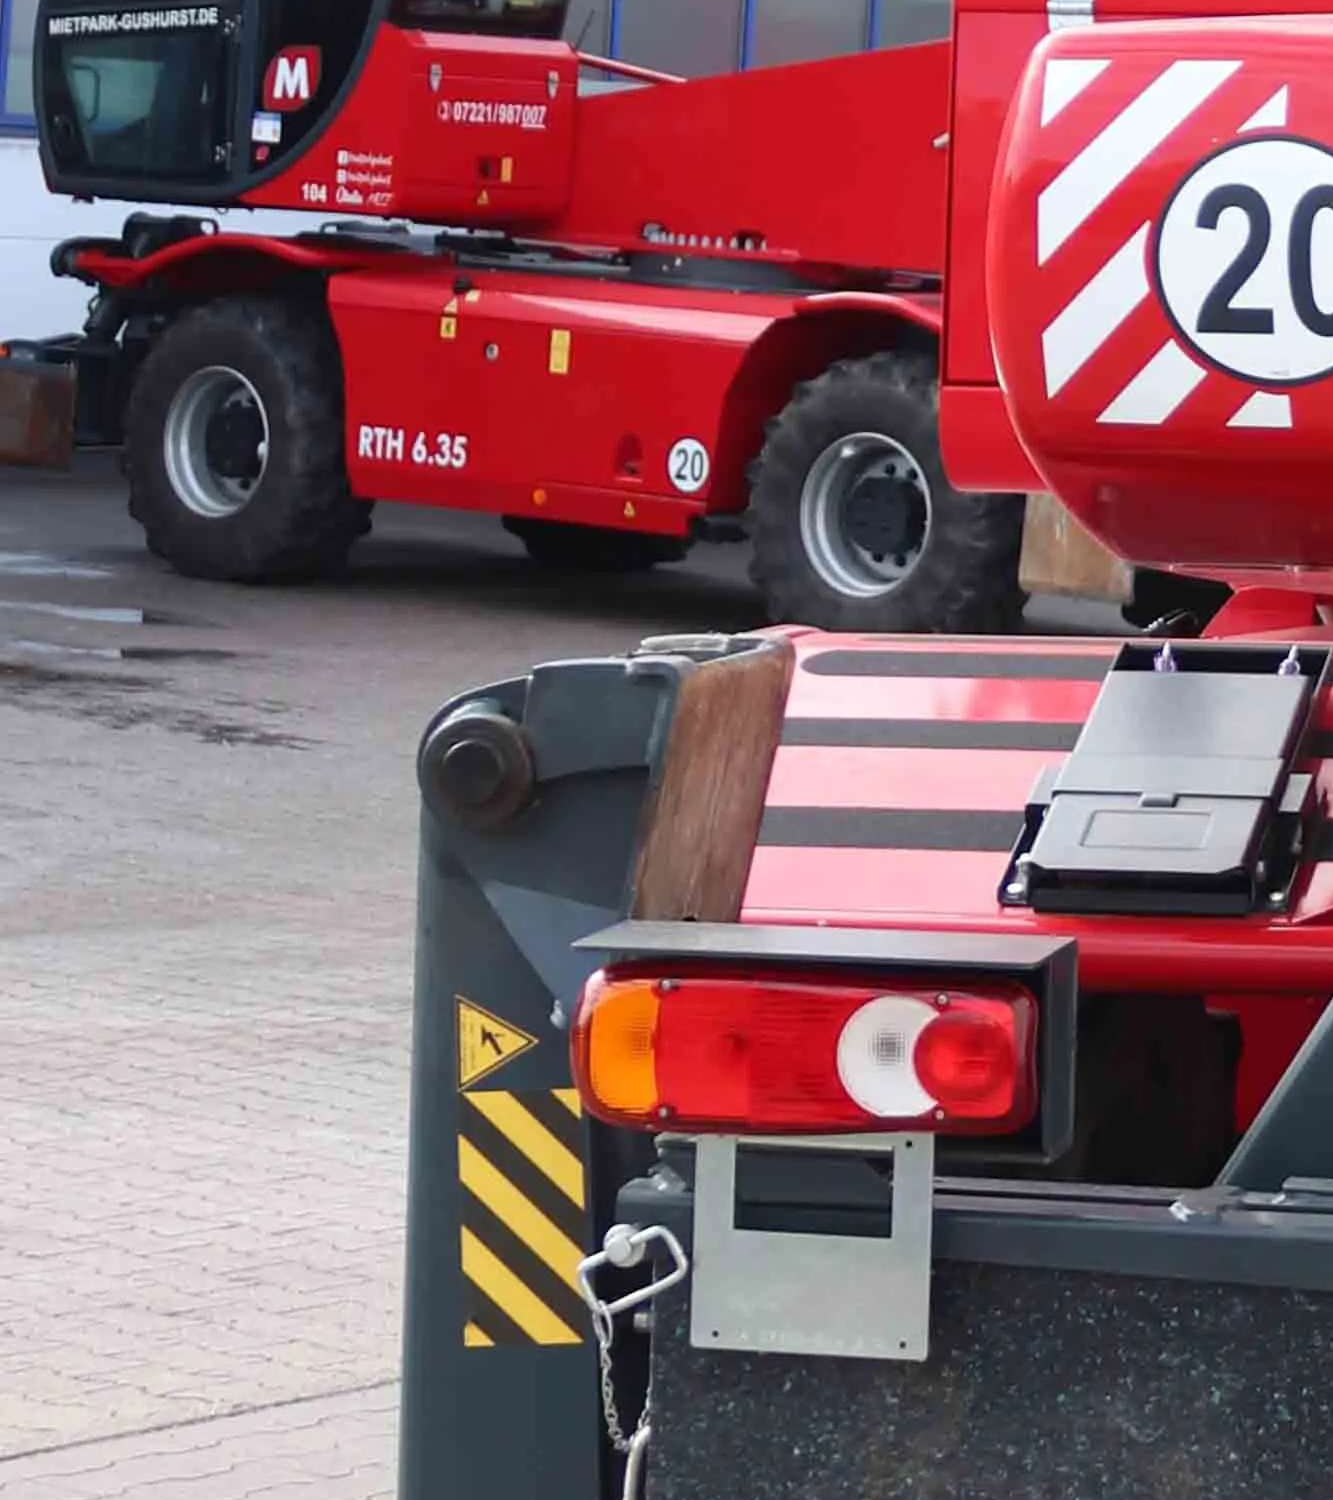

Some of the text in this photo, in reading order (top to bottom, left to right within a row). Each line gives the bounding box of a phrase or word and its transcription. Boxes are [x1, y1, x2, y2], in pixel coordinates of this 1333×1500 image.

[49, 7, 219, 35] MIETPARK-GUSHURST.DE
[272, 56, 310, 100] M
[301, 182, 328, 204] 104
[358, 424, 468, 469] RTH 6.35
[674, 447, 704, 483] 20
